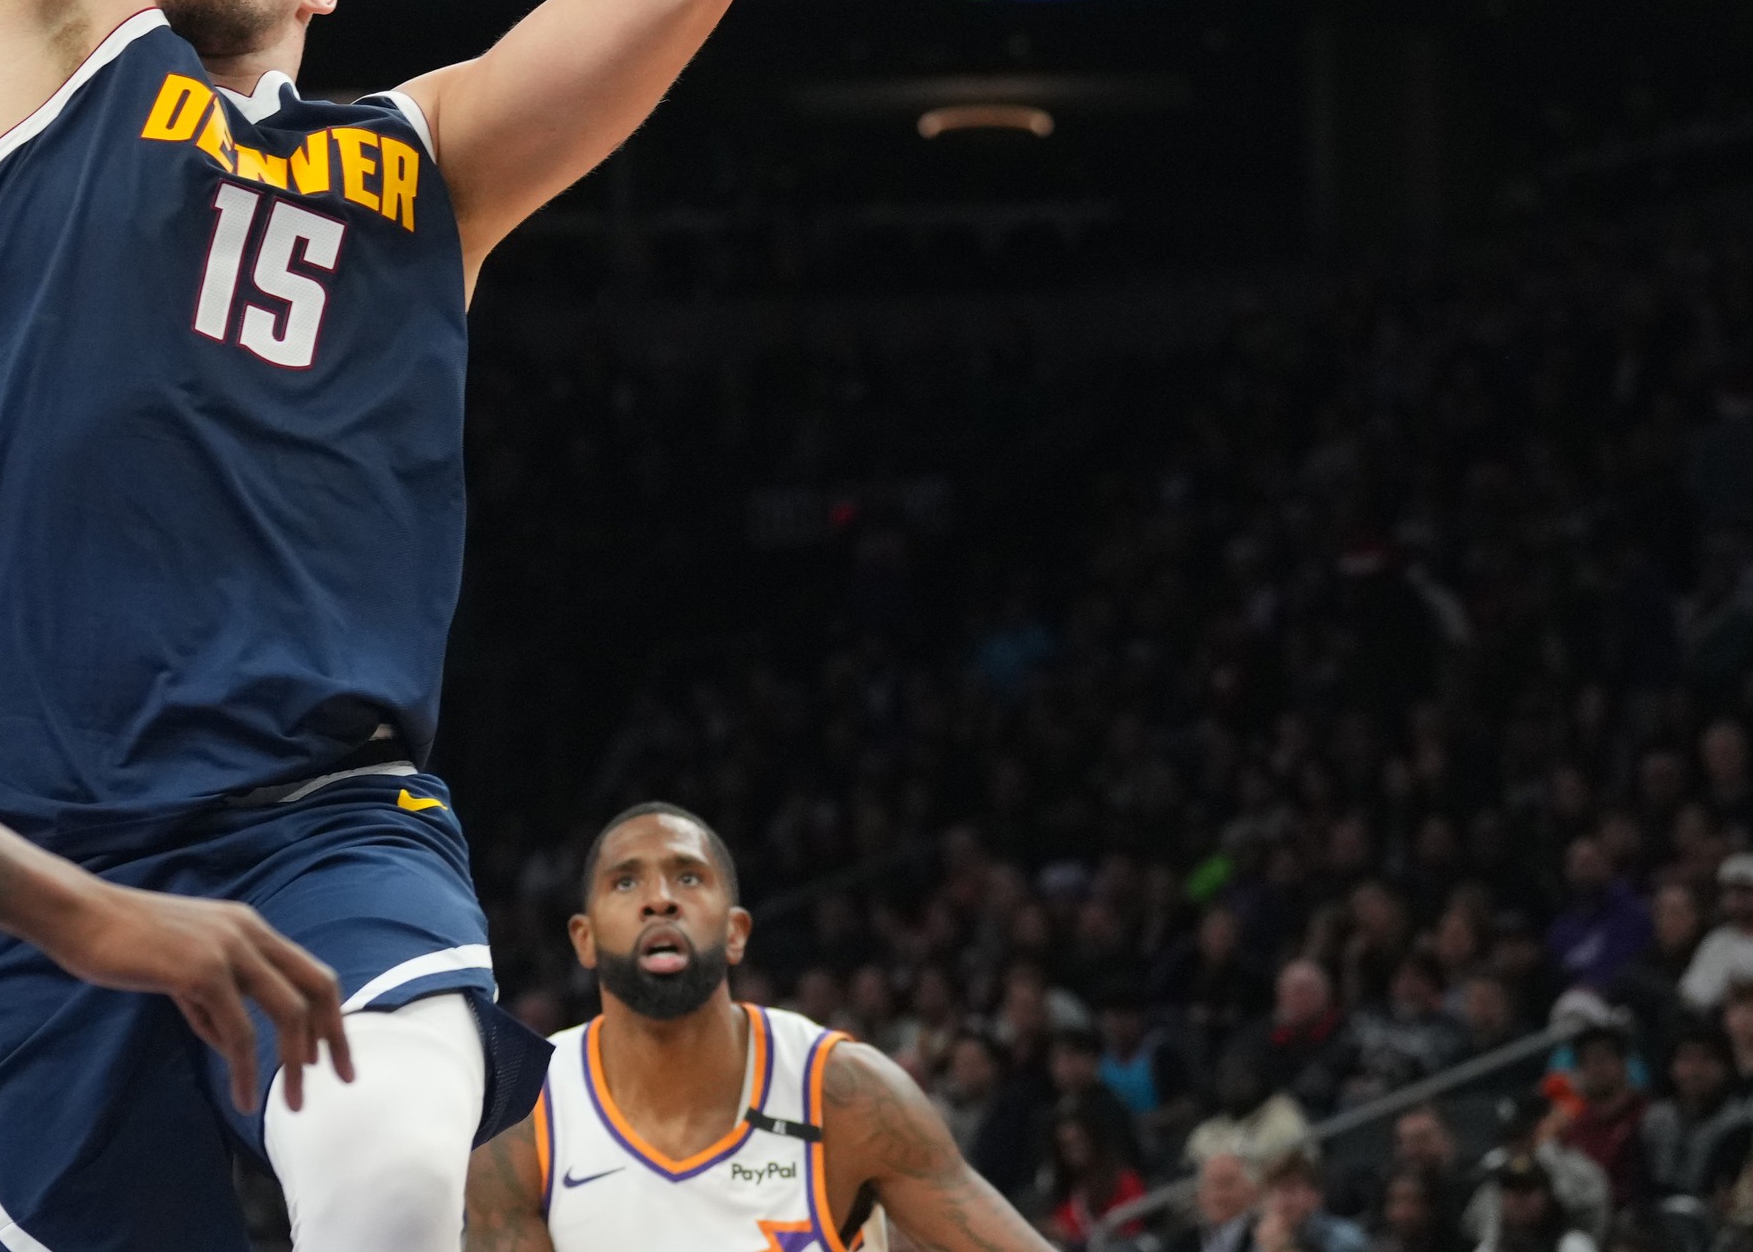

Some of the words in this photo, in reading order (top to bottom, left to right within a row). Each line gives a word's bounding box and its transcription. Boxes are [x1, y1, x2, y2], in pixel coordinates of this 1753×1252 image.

[140, 72, 419, 233] DENVER
[192, 178, 347, 370] 15
[731, 1161, 796, 1186] PayPal
